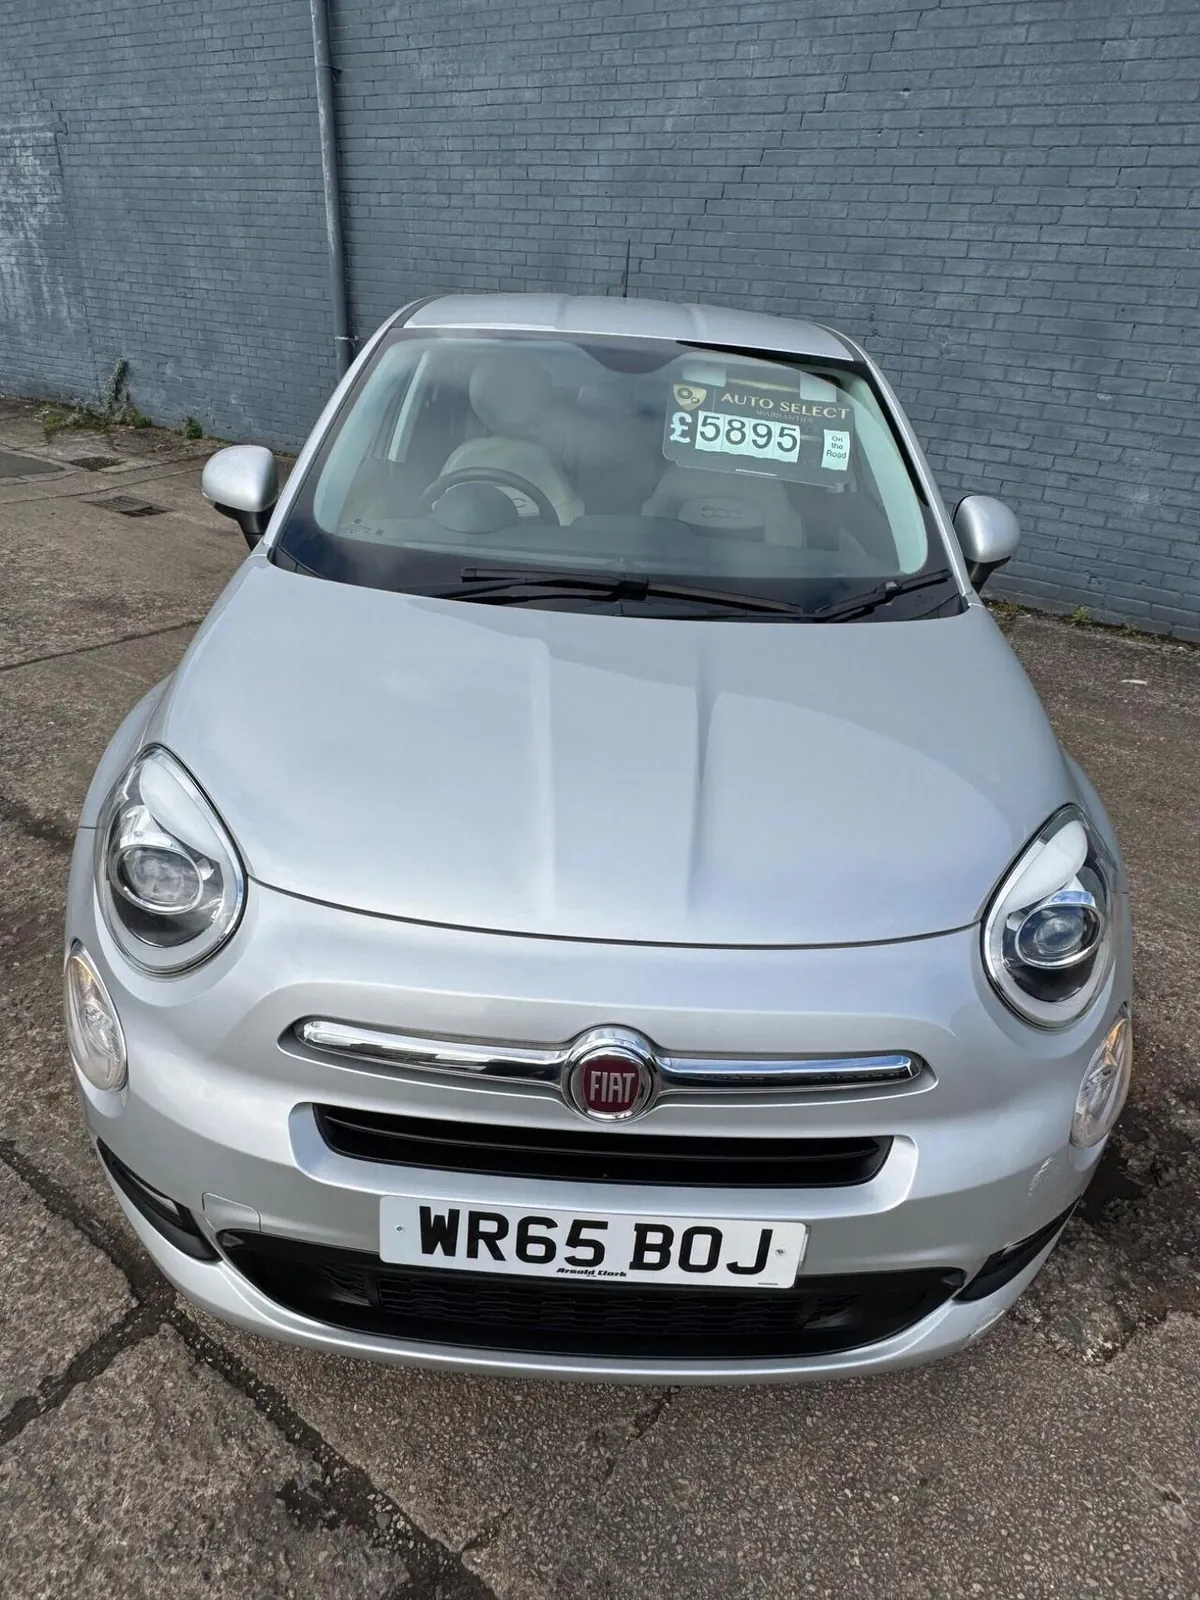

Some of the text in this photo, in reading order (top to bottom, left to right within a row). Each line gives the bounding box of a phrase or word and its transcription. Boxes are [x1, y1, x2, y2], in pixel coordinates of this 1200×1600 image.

[720, 392, 850, 420] AUTO SELECT
[831, 435, 843, 443] On
[831, 442, 844, 450] the
[826, 449, 847, 459] Road
[589, 1070, 636, 1103] FIAT
[418, 1205, 774, 1276] WR65 BOJ
[556, 1267, 596, 1276] Arnold
[597, 1269, 628, 1278] Clark
